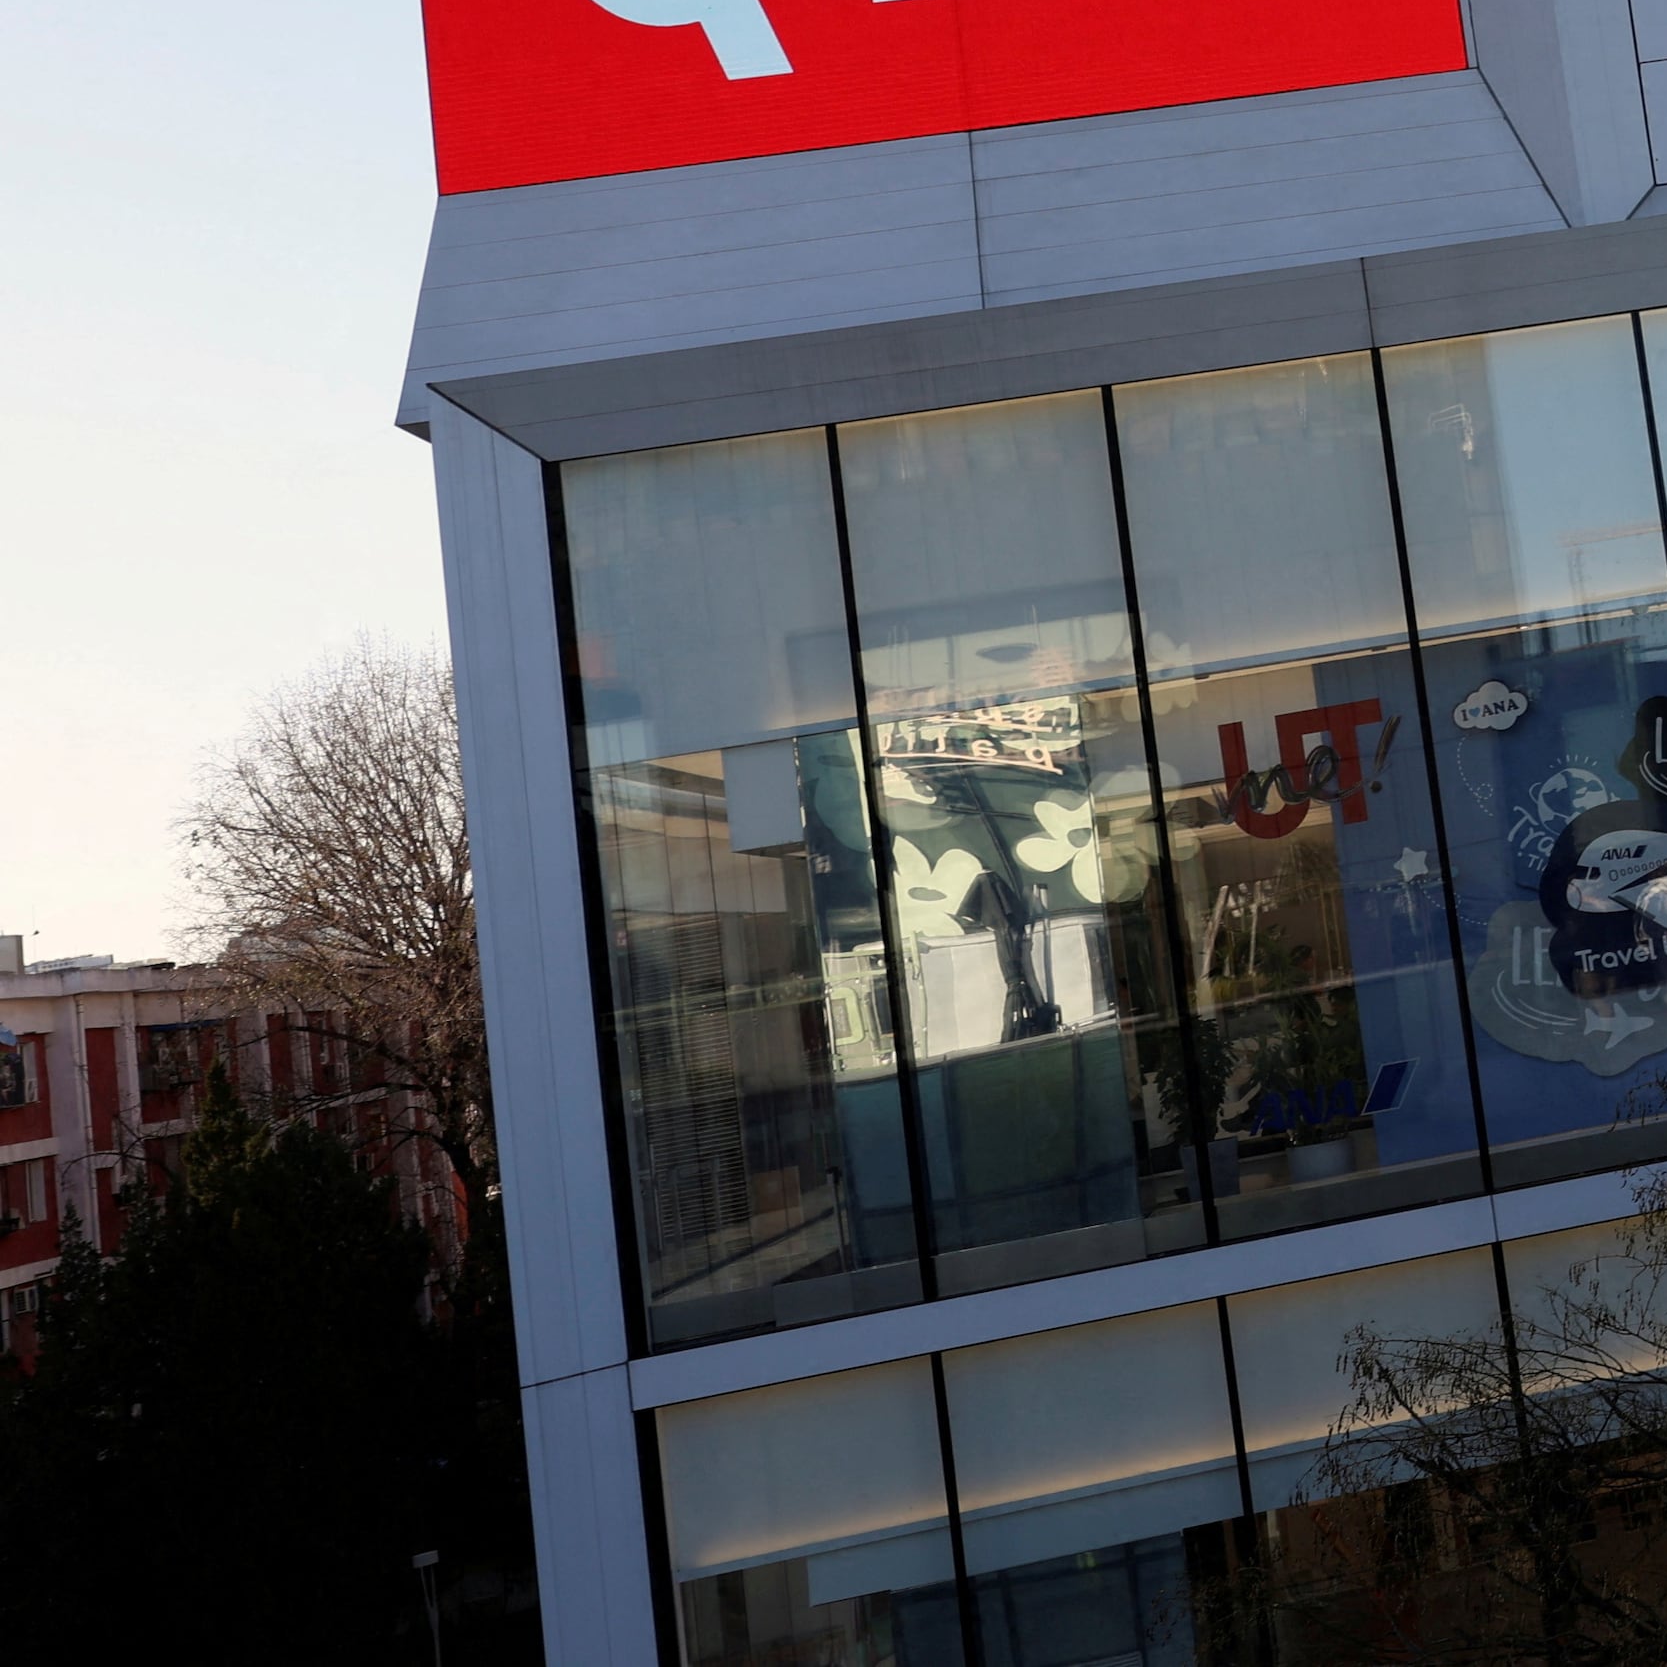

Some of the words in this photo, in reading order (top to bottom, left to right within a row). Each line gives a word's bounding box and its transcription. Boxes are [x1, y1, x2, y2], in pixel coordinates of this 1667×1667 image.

[1481, 698, 1519, 718] ANA
[1218, 698, 1382, 839] UT
[1601, 847, 1632, 862] ANA
[1574, 937, 1658, 974] Travel
[1249, 1078, 1362, 1136] ANA
